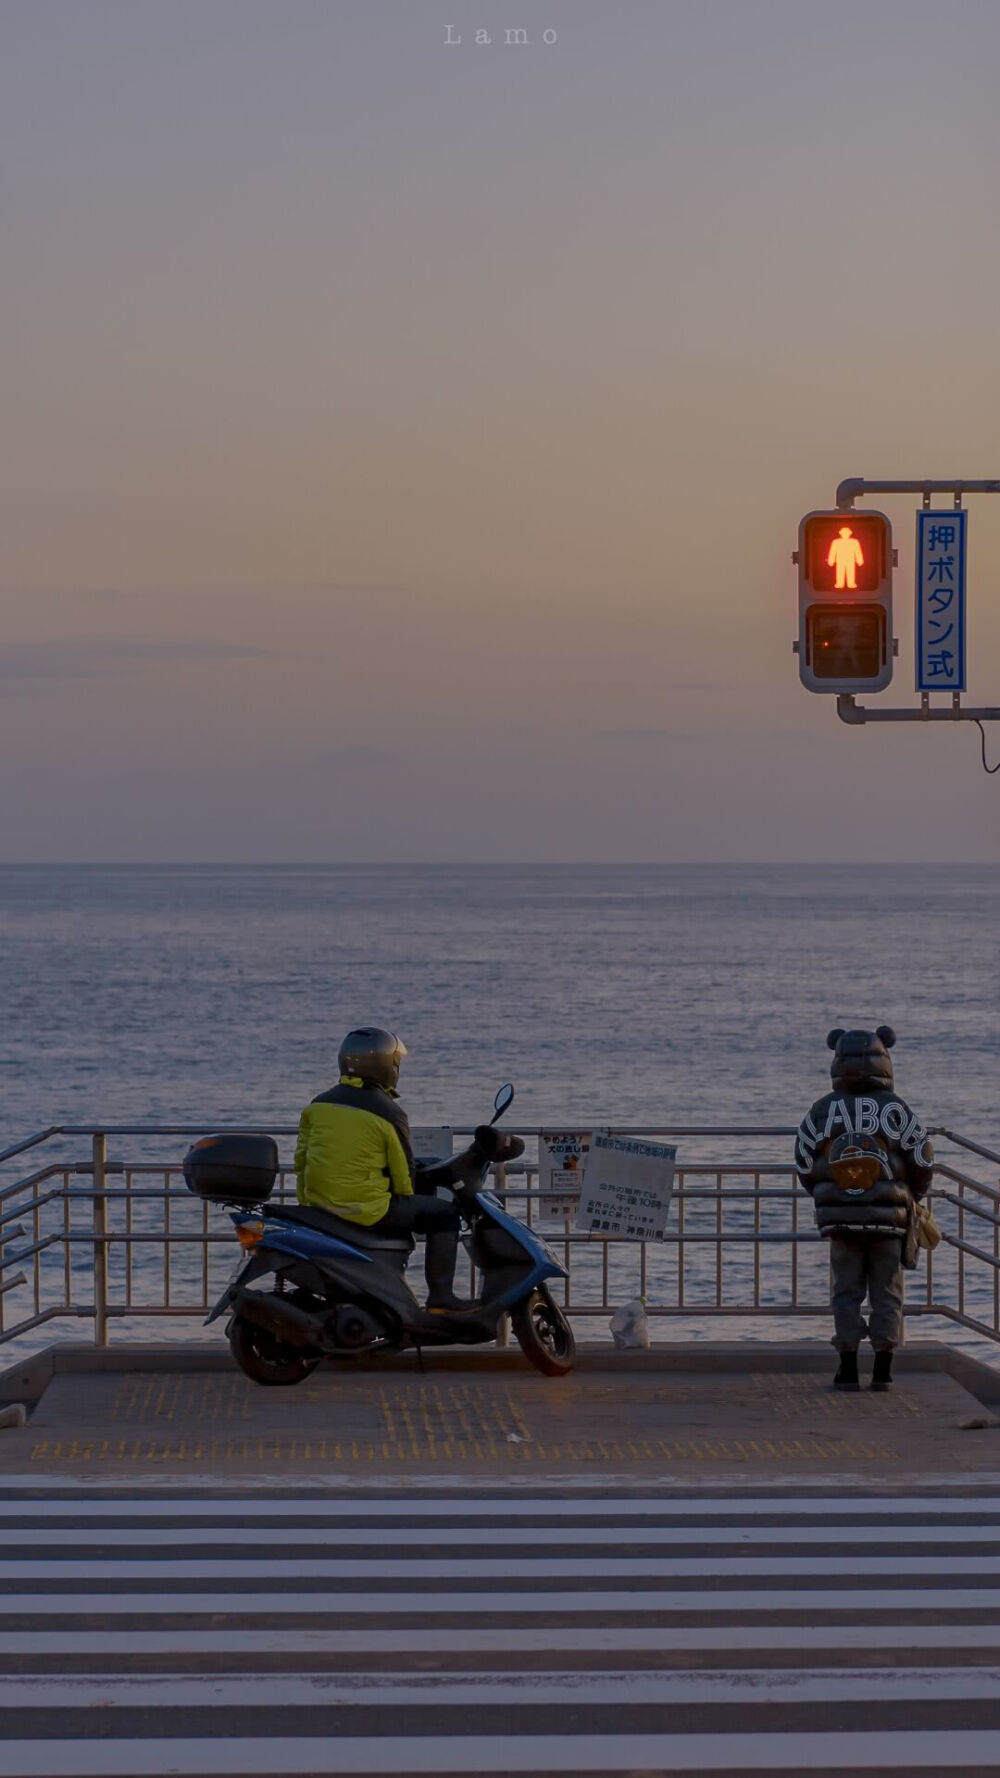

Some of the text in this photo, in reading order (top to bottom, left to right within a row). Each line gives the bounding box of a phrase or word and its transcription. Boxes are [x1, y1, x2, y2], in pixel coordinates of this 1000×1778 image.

[928, 525, 955, 678] 押ボタン式
